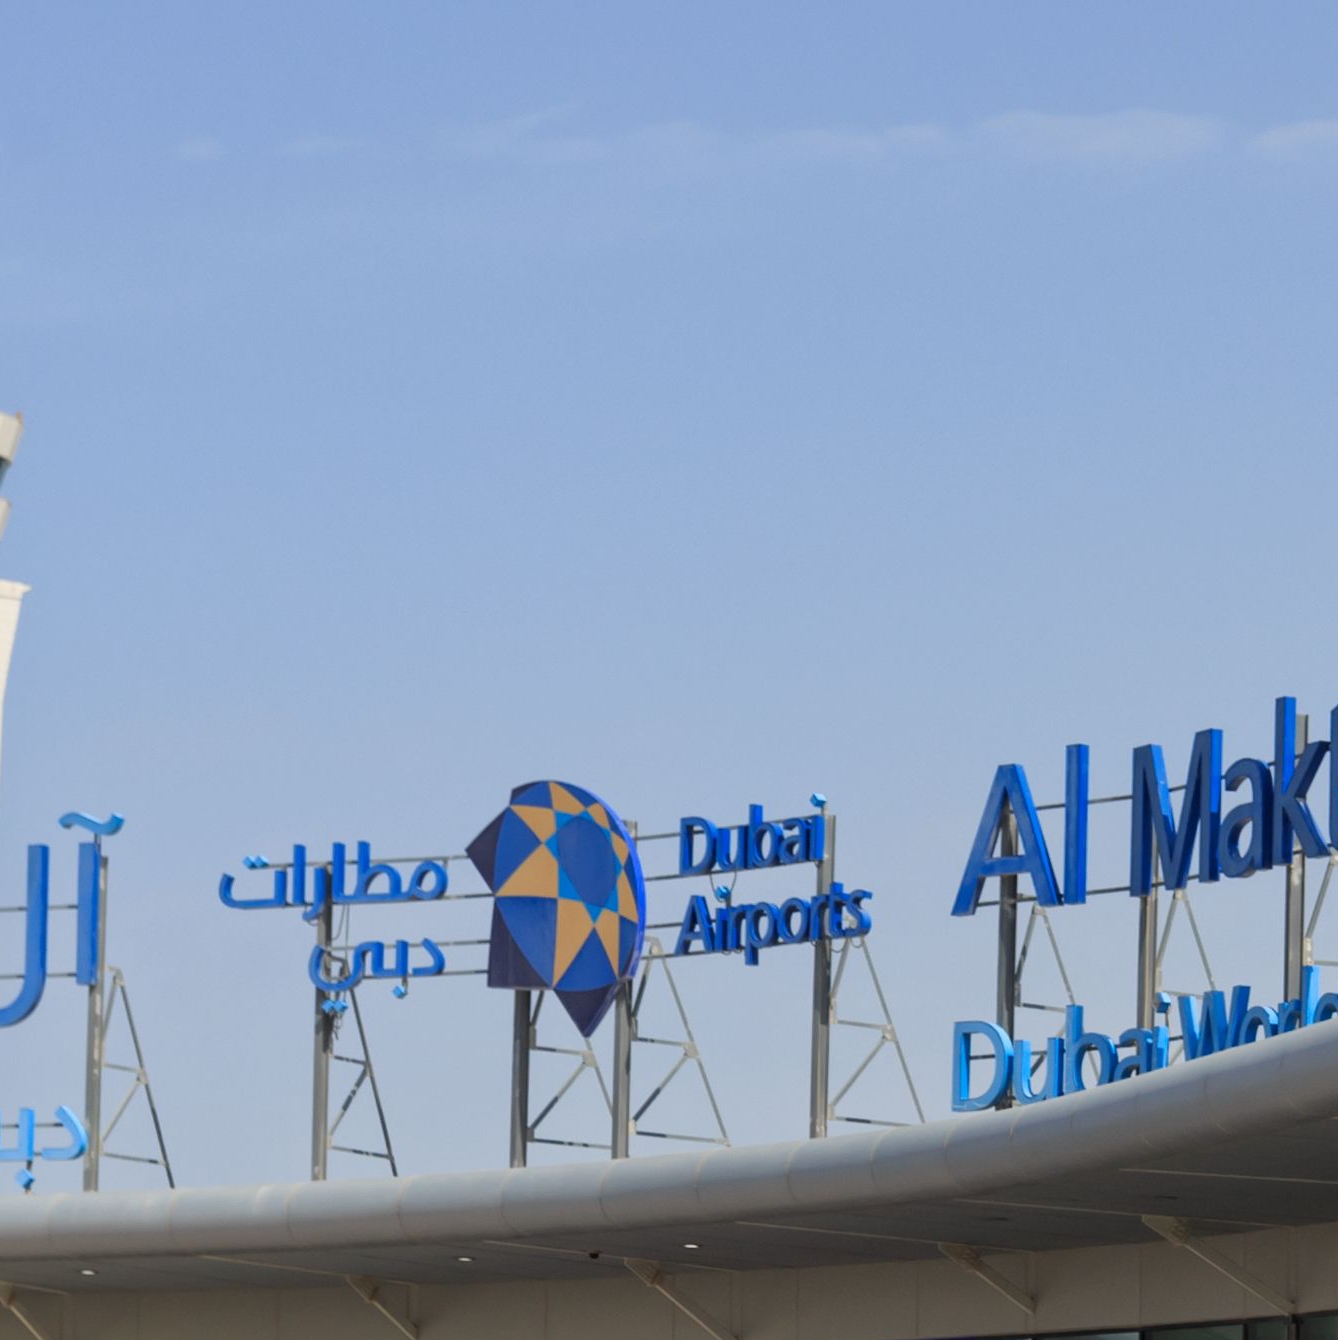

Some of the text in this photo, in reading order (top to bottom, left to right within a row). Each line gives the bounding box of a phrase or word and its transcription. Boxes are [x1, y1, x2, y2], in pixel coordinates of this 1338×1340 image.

[679, 792, 827, 877] Dubai
[951, 743, 1090, 917] Al
[218, 840, 449, 922] مطارات
[674, 881, 873, 967] Airports
[308, 936, 446, 1015] دبي
[951, 992, 1170, 1113] Dubai
